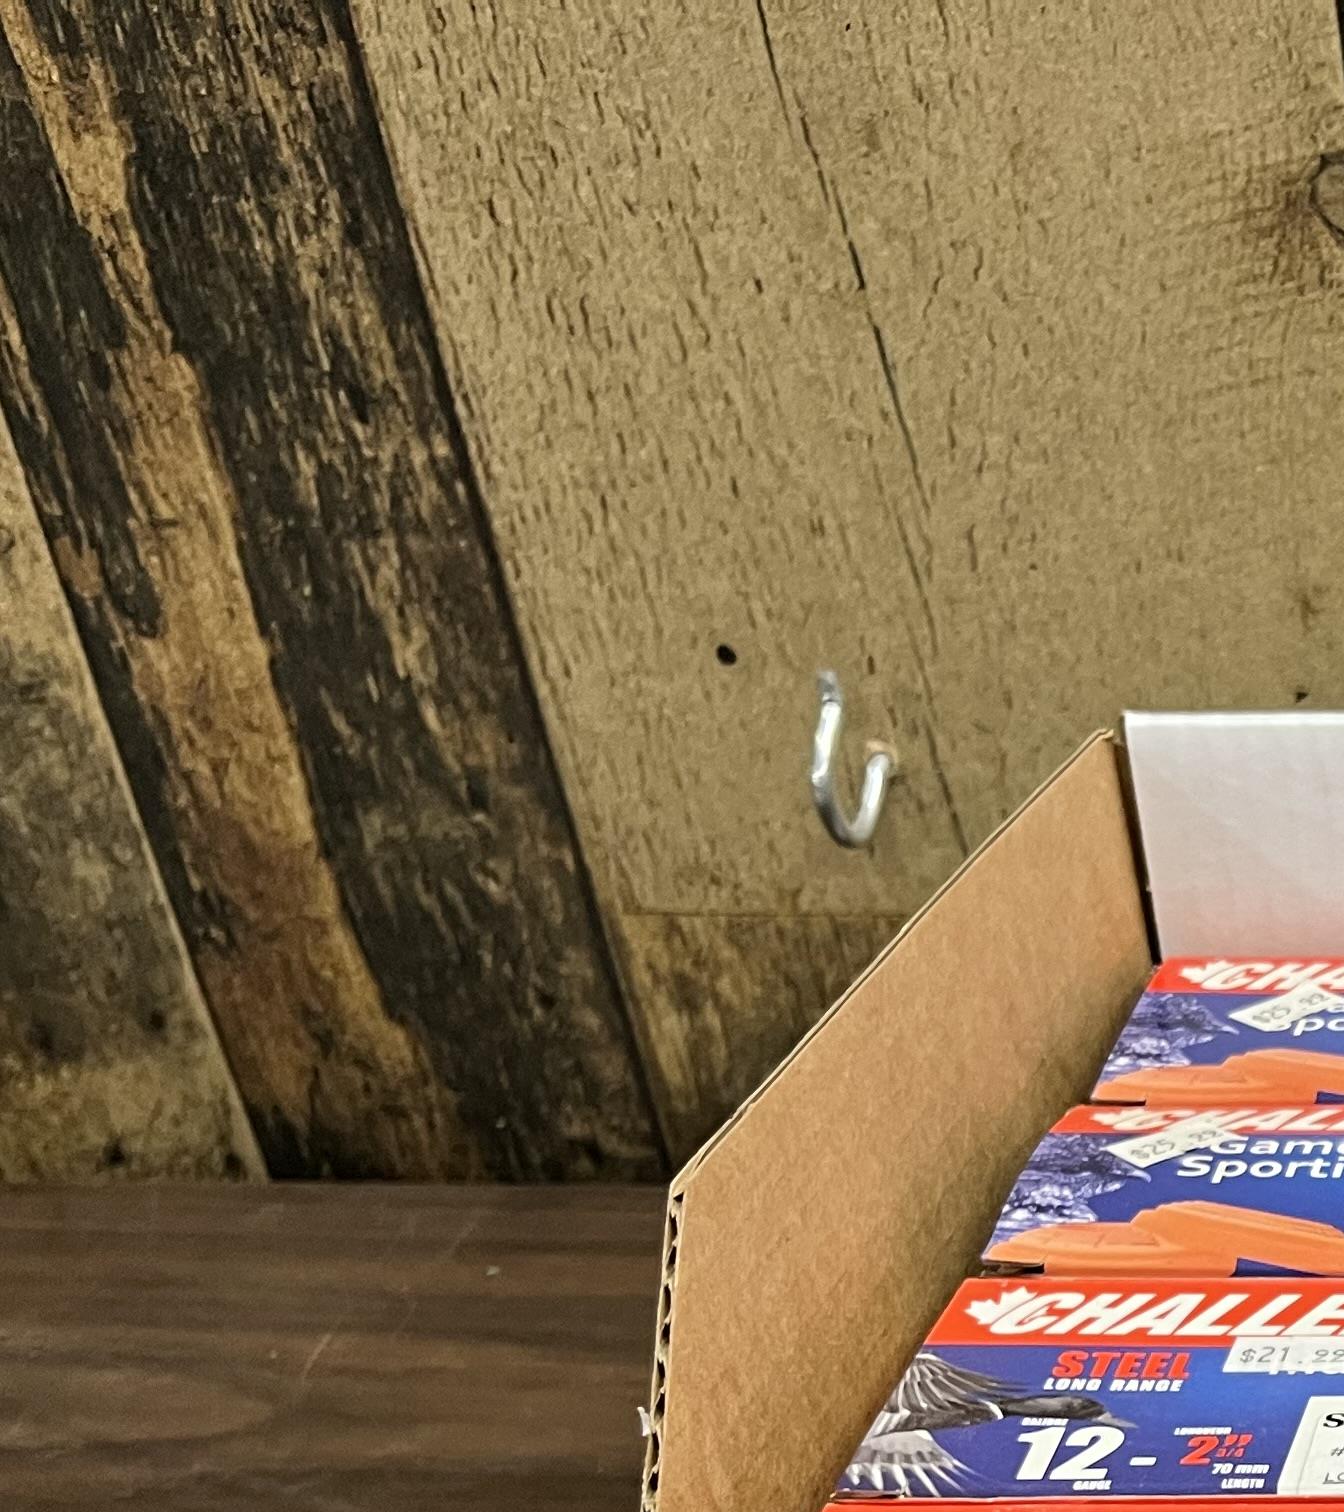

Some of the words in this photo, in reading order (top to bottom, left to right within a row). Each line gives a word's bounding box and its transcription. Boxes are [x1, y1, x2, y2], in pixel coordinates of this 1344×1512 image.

[1052, 1350, 1190, 1381] STEEL
[1043, 1378, 1101, 1392] LONG
[1110, 1379, 1185, 1393] RANGE
[1016, 1425, 1126, 1482] 12
